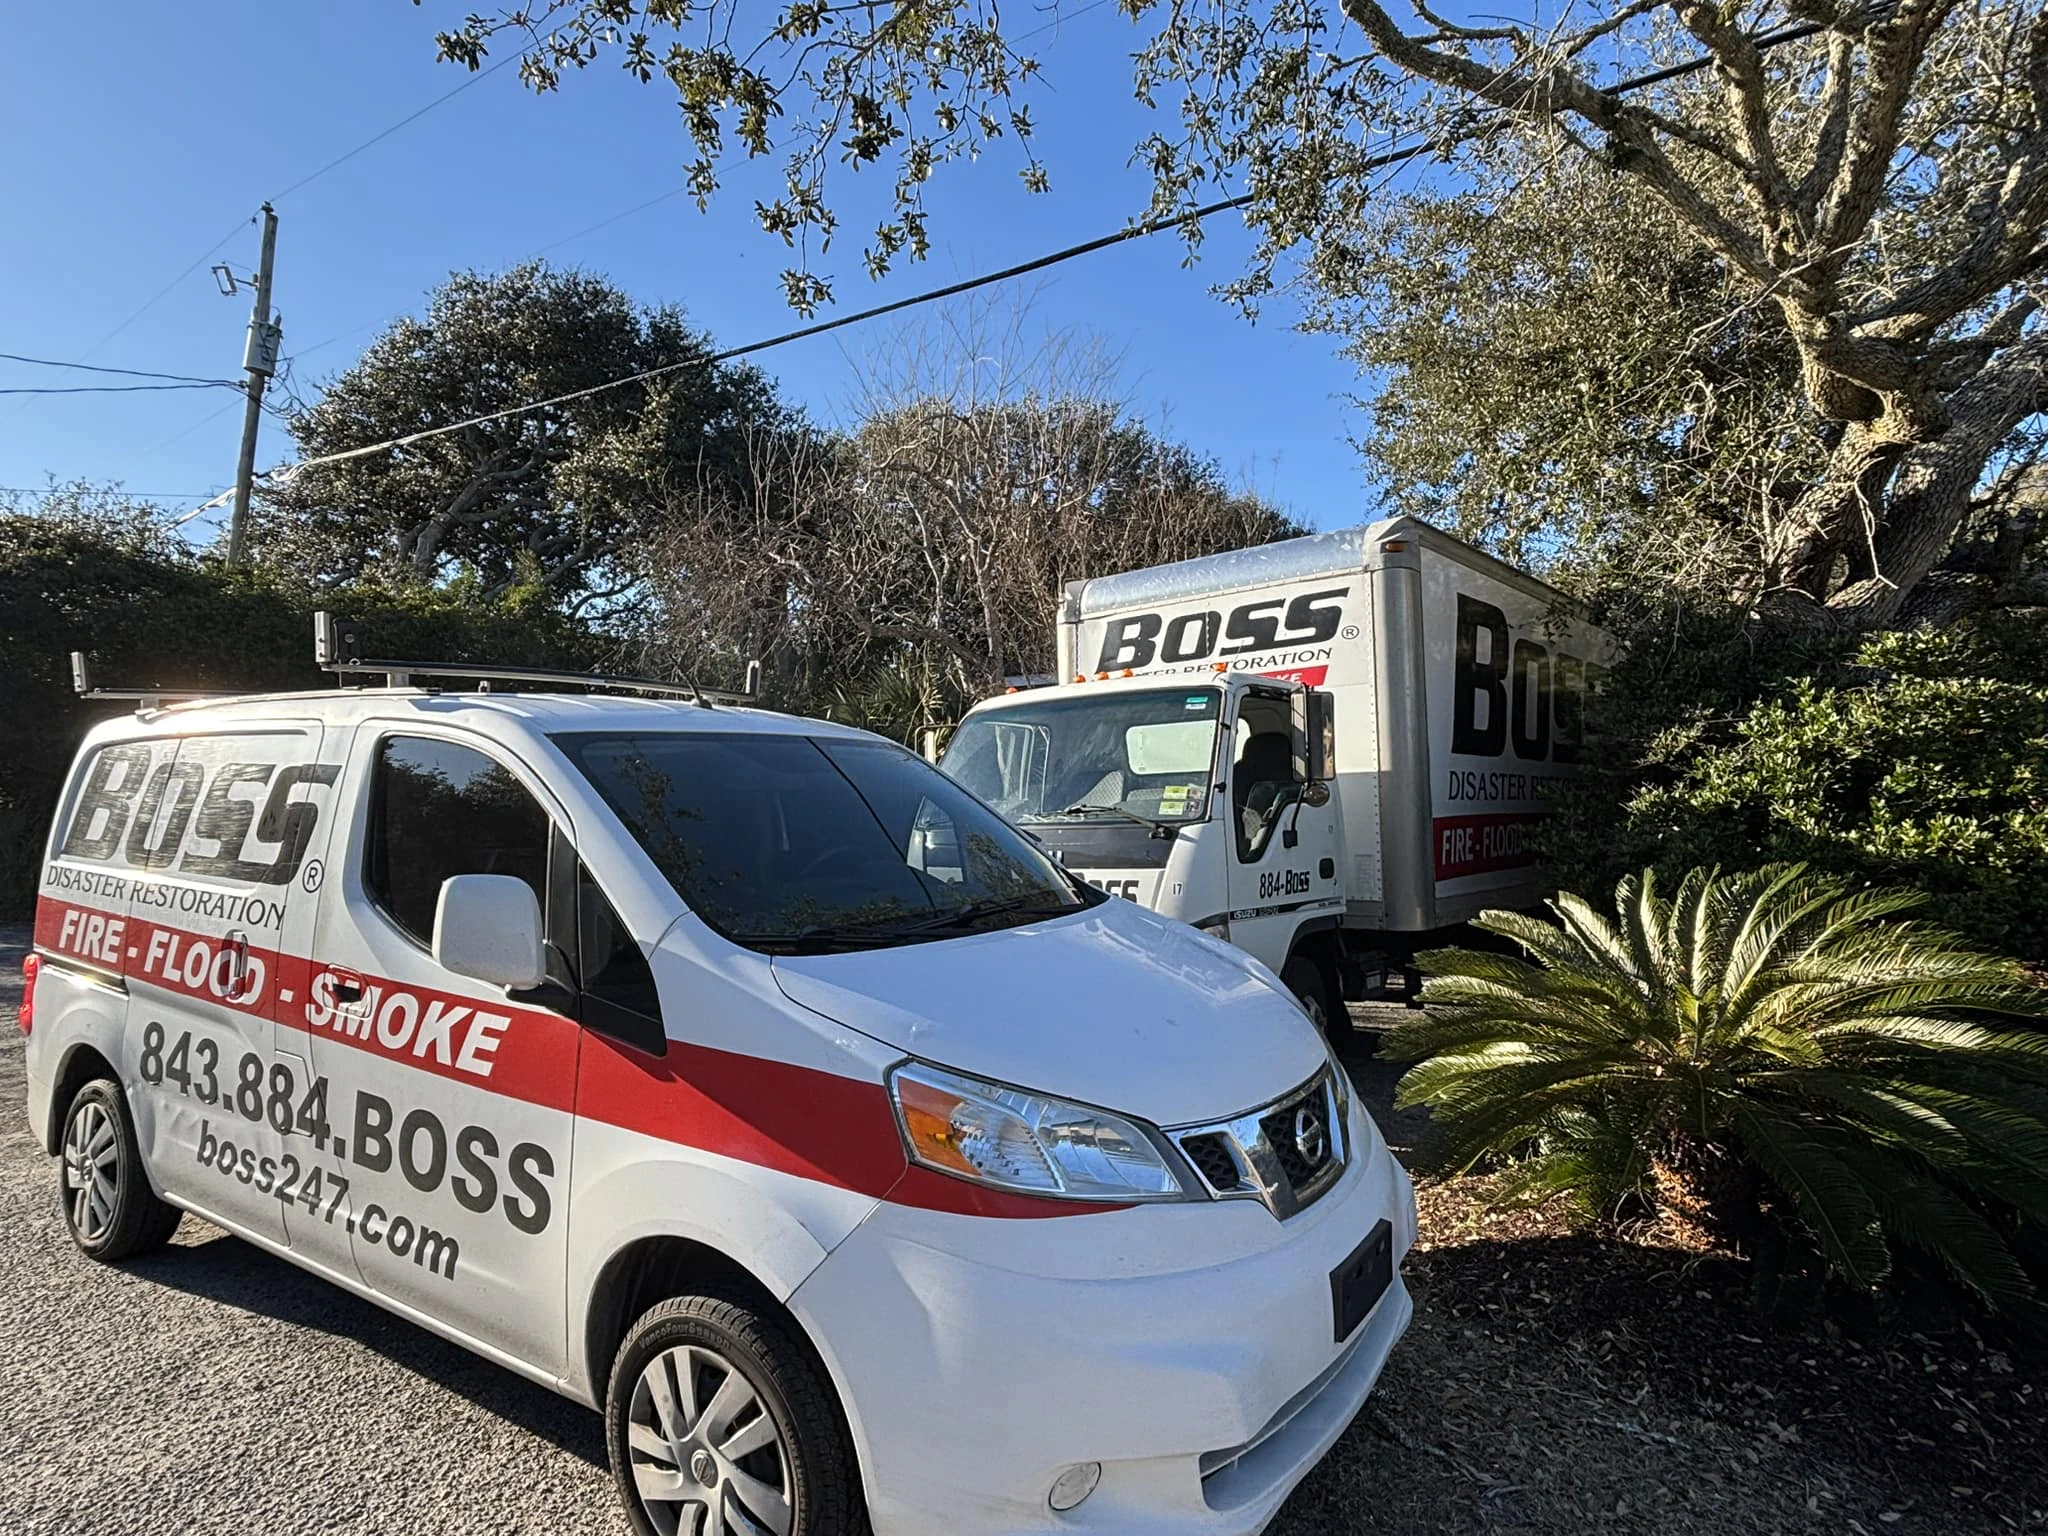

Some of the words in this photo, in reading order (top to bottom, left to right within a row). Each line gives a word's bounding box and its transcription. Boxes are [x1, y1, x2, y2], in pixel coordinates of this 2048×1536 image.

[1095, 587, 1350, 674] BOSS
[60, 744, 343, 886] BOSS
[1449, 771, 1526, 801] DISASTER
[1172, 883, 1183, 895] 17
[1442, 827, 1474, 864] FIRE
[46, 868, 125, 900] DISASTER
[131, 881, 286, 931] RESTORATION
[58, 910, 126, 964] FIRE
[143, 930, 266, 1005] FLOOD
[305, 972, 512, 1077] SMOKE
[140, 1021, 555, 1235] 843.884.BOSS
[197, 1119, 460, 1280] boss247.com
